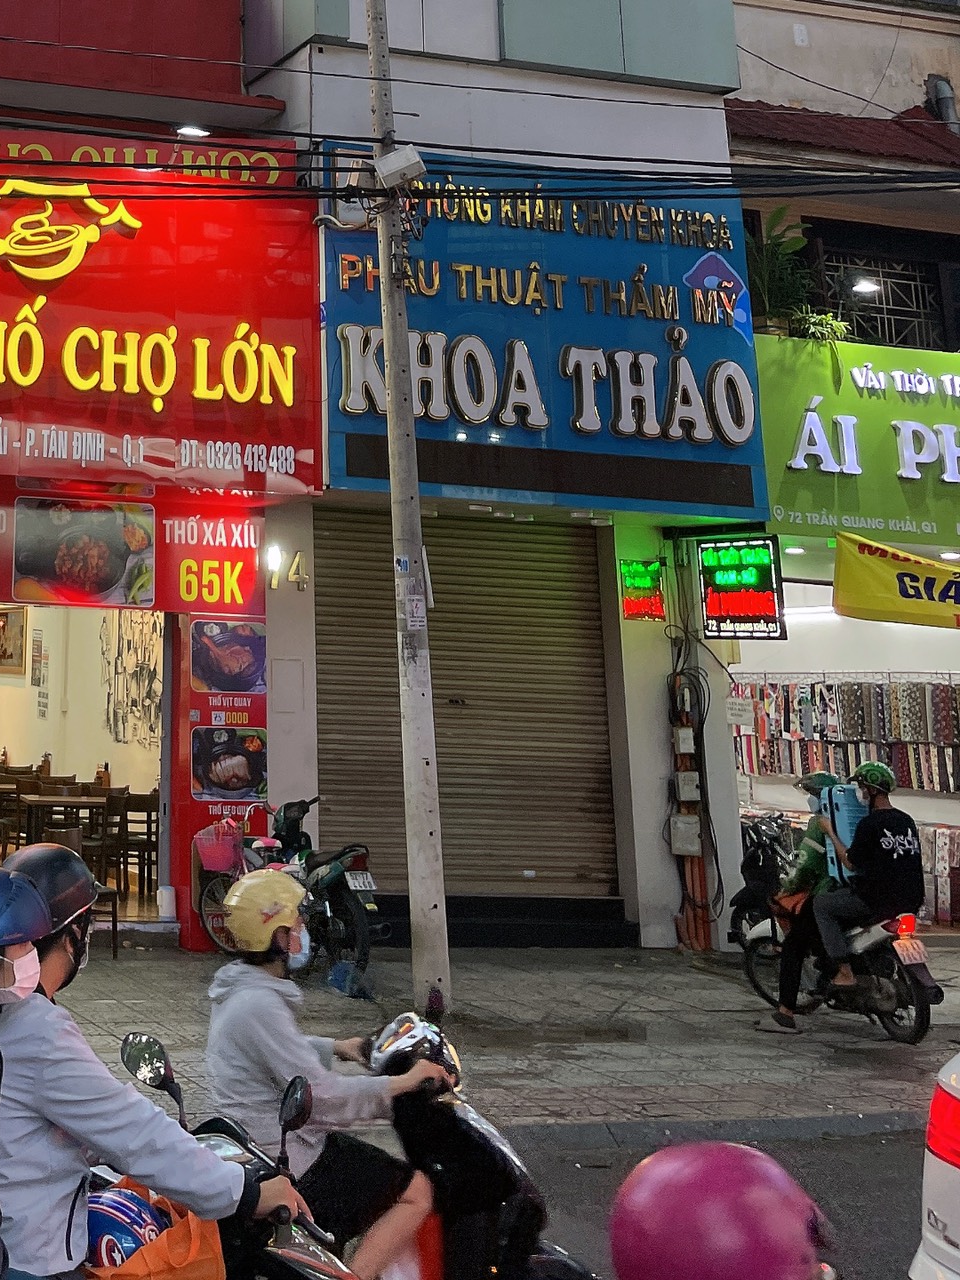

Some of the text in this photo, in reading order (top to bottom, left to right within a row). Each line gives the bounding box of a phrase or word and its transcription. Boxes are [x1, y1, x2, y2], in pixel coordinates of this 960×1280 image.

[667, 208, 734, 250] KHOA
[450, 263, 569, 315] THUẬT
[578, 263, 680, 320] THẨM
[692, 280, 736, 327] MỸ
[60, 325, 178, 412] CHỢ
[191, 322, 297, 407] LỚN
[337, 324, 757, 449] KHOA THẢO
[851, 362, 886, 390] VẢI
[890, 367, 936, 395] THỜI
[72, 431, 105, 468] ĐỊNH
[180, 438, 203, 468] ĐT:
[206, 440, 241, 470] 0326
[787, 395, 863, 475] ÁI
[162, 514, 260, 549] THỐ XÁ XÍU
[788, 511, 803, 523] 72
[805, 508, 838, 526] TRẦN
[841, 515, 884, 529] QUANG
[179, 558, 244, 605] 65K
